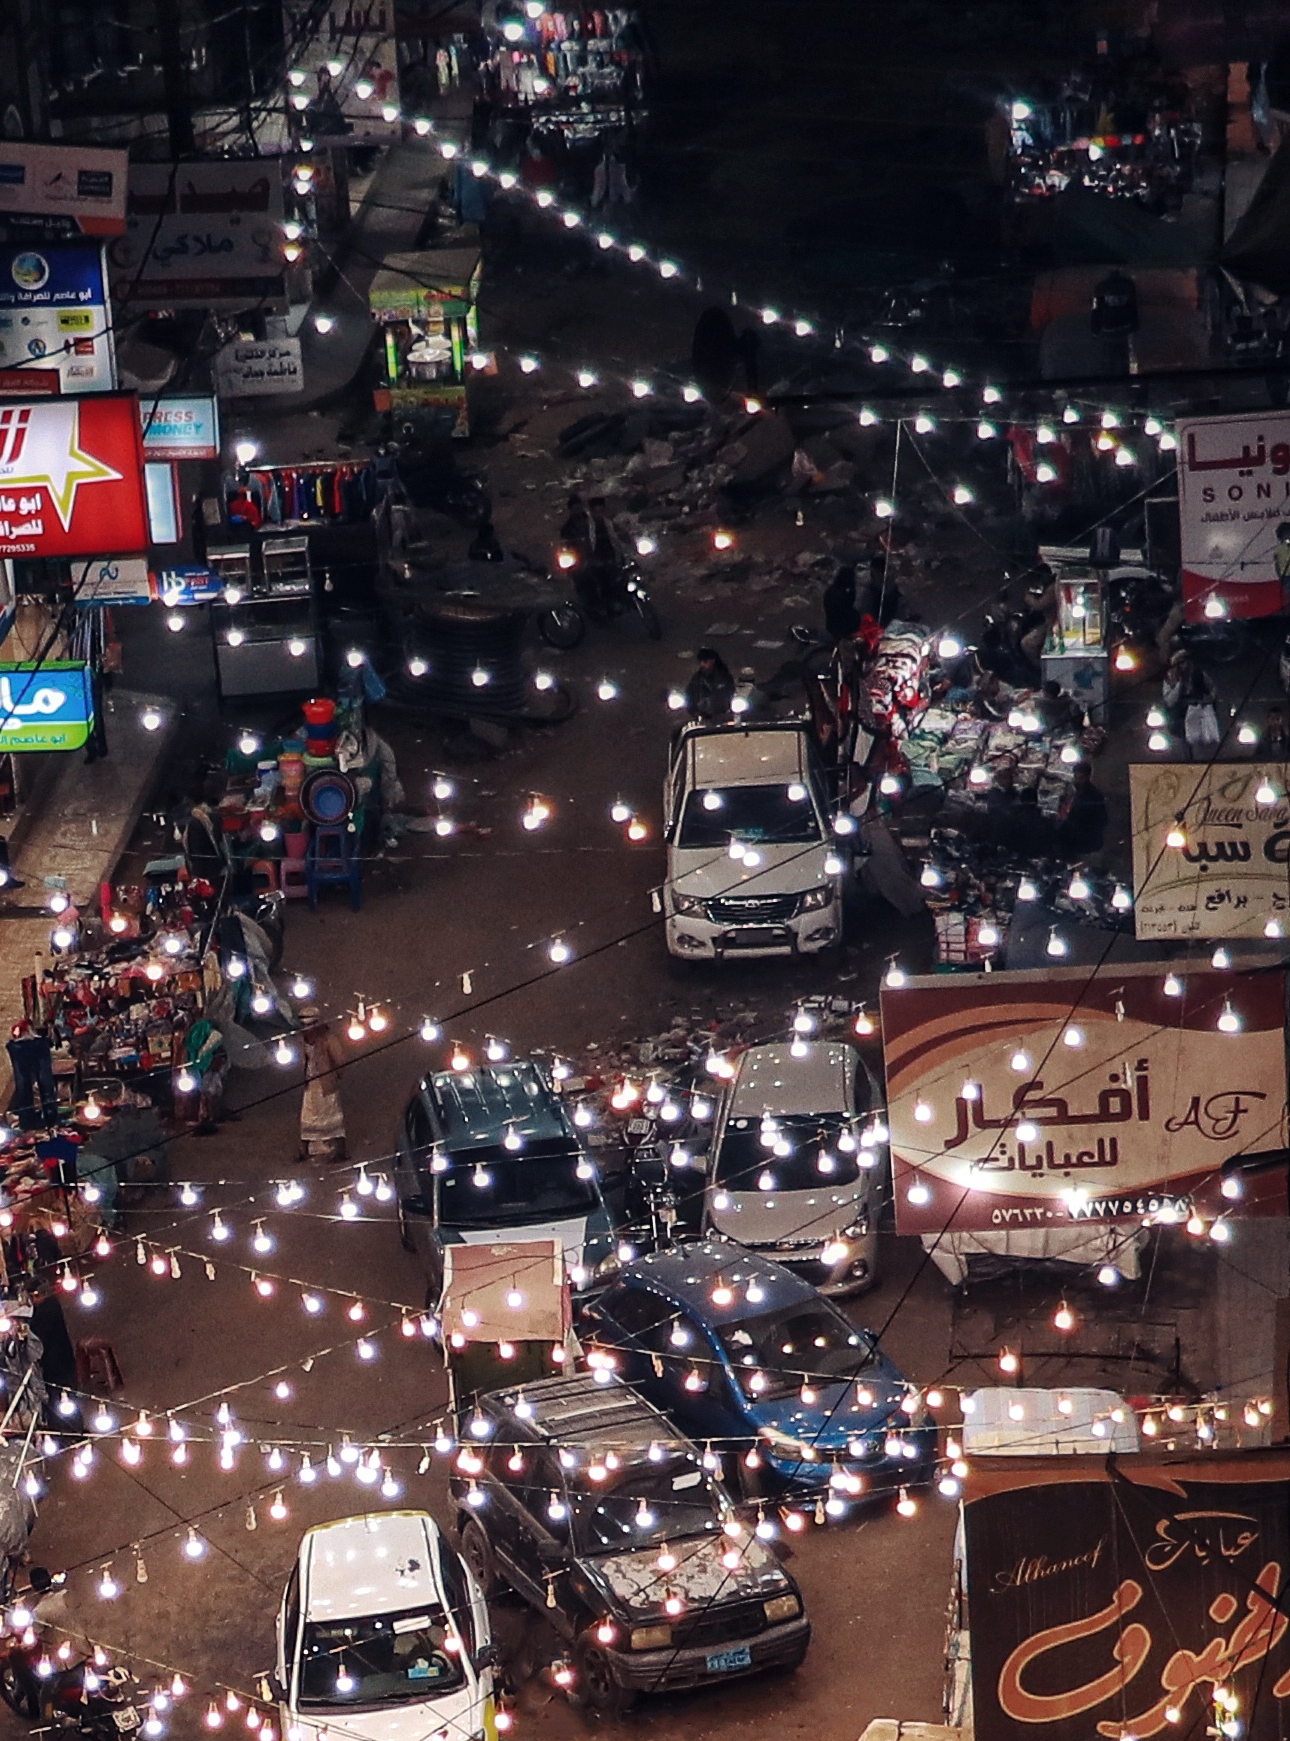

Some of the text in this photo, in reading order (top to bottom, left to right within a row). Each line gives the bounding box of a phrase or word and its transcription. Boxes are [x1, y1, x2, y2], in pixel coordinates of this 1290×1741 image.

[9, 734, 48, 747] عاصم
[943, 1058, 1150, 1150] أفكار
[973, 1137, 1119, 1178] للعبايات
